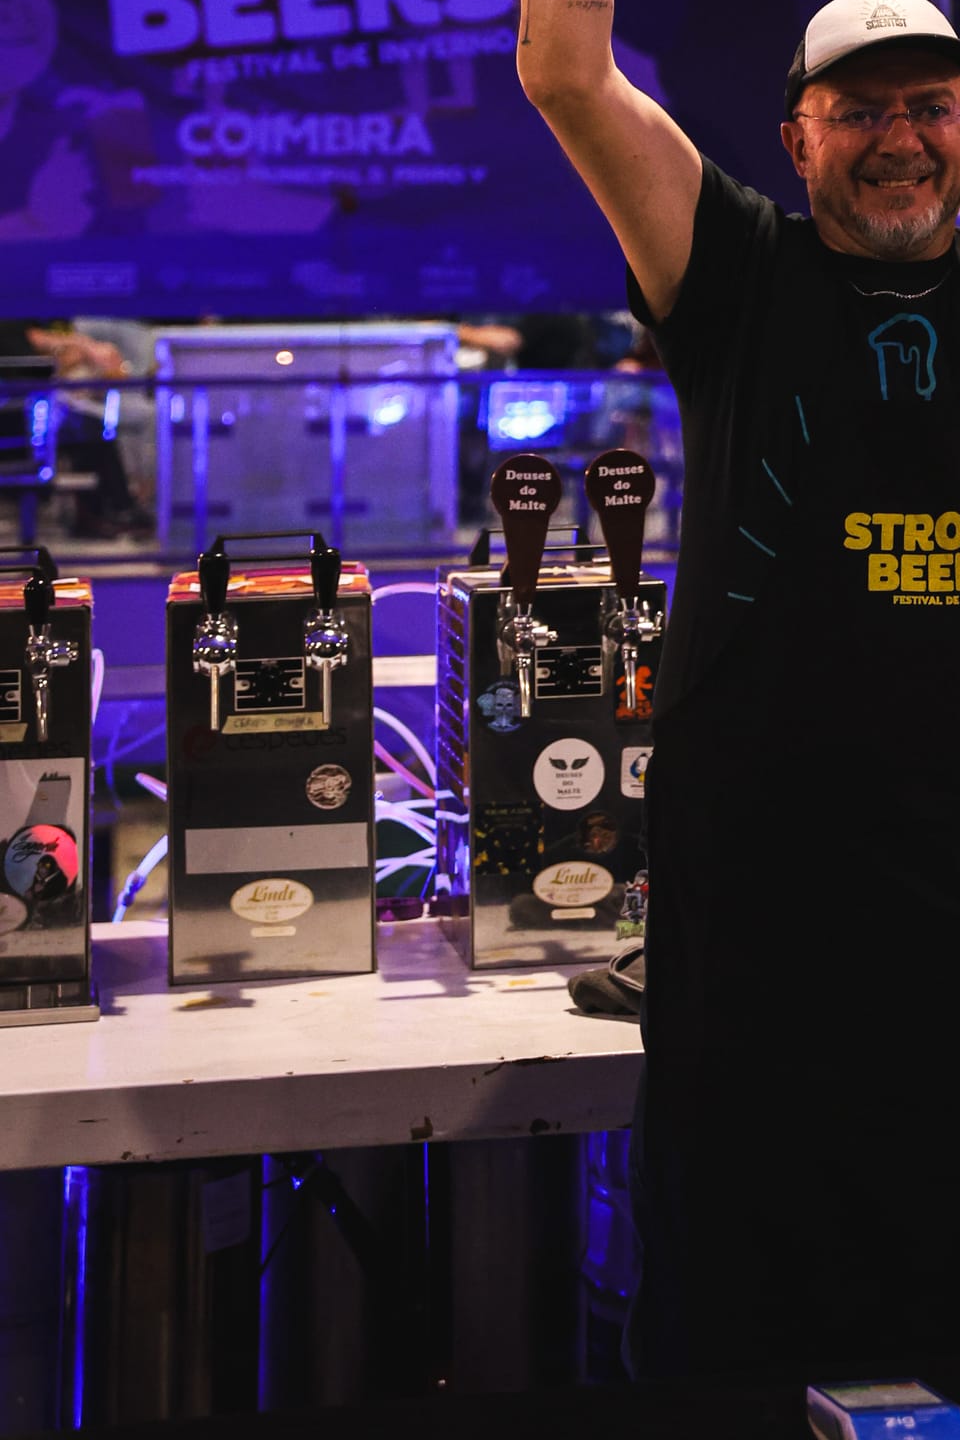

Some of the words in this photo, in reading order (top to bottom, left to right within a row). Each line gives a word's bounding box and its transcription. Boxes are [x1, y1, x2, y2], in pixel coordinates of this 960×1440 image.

[178, 112, 435, 157] COIMBRA
[506, 470, 552, 481] Deuses
[598, 465, 644, 477] Deuses
[519, 485, 537, 496] do
[613, 480, 631, 491] do
[509, 500, 547, 511] Malte
[604, 494, 642, 506] Malte
[893, 595, 943, 605] FESTIVAL
[945, 596, 960, 605] DE
